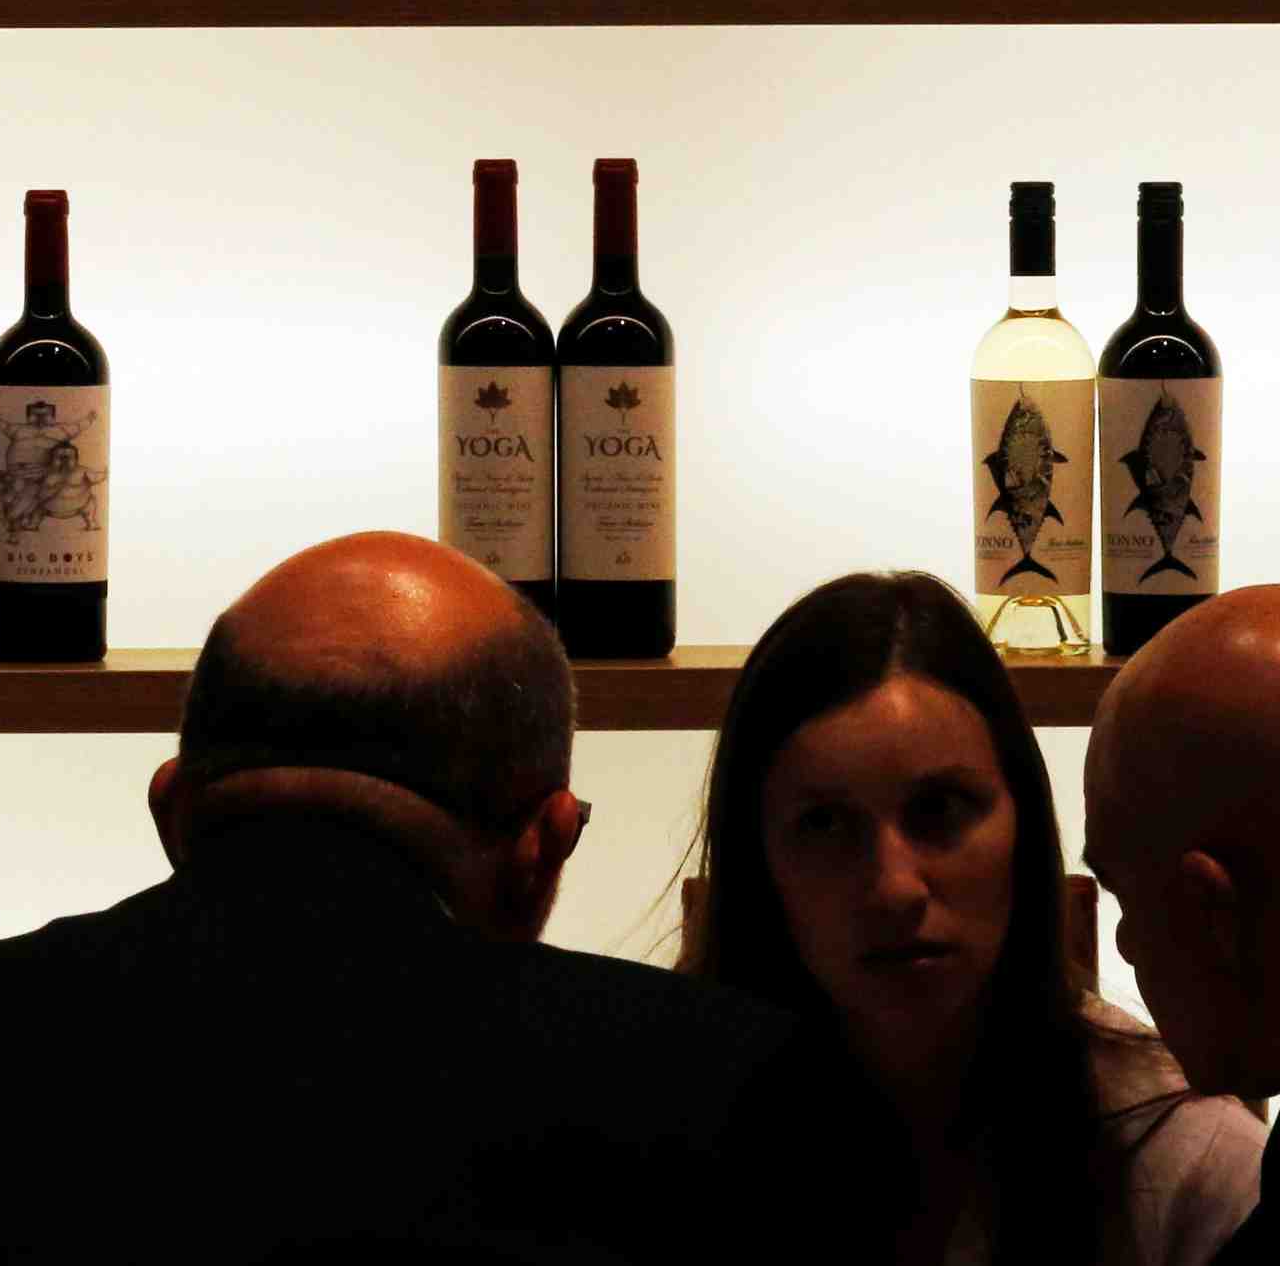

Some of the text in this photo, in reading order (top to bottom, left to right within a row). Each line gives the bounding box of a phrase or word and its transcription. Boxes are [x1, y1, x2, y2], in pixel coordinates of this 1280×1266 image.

[456, 434, 535, 462] YOGA
[584, 434, 663, 462] YOGA
[8, 552, 94, 563] BIG BOYS
